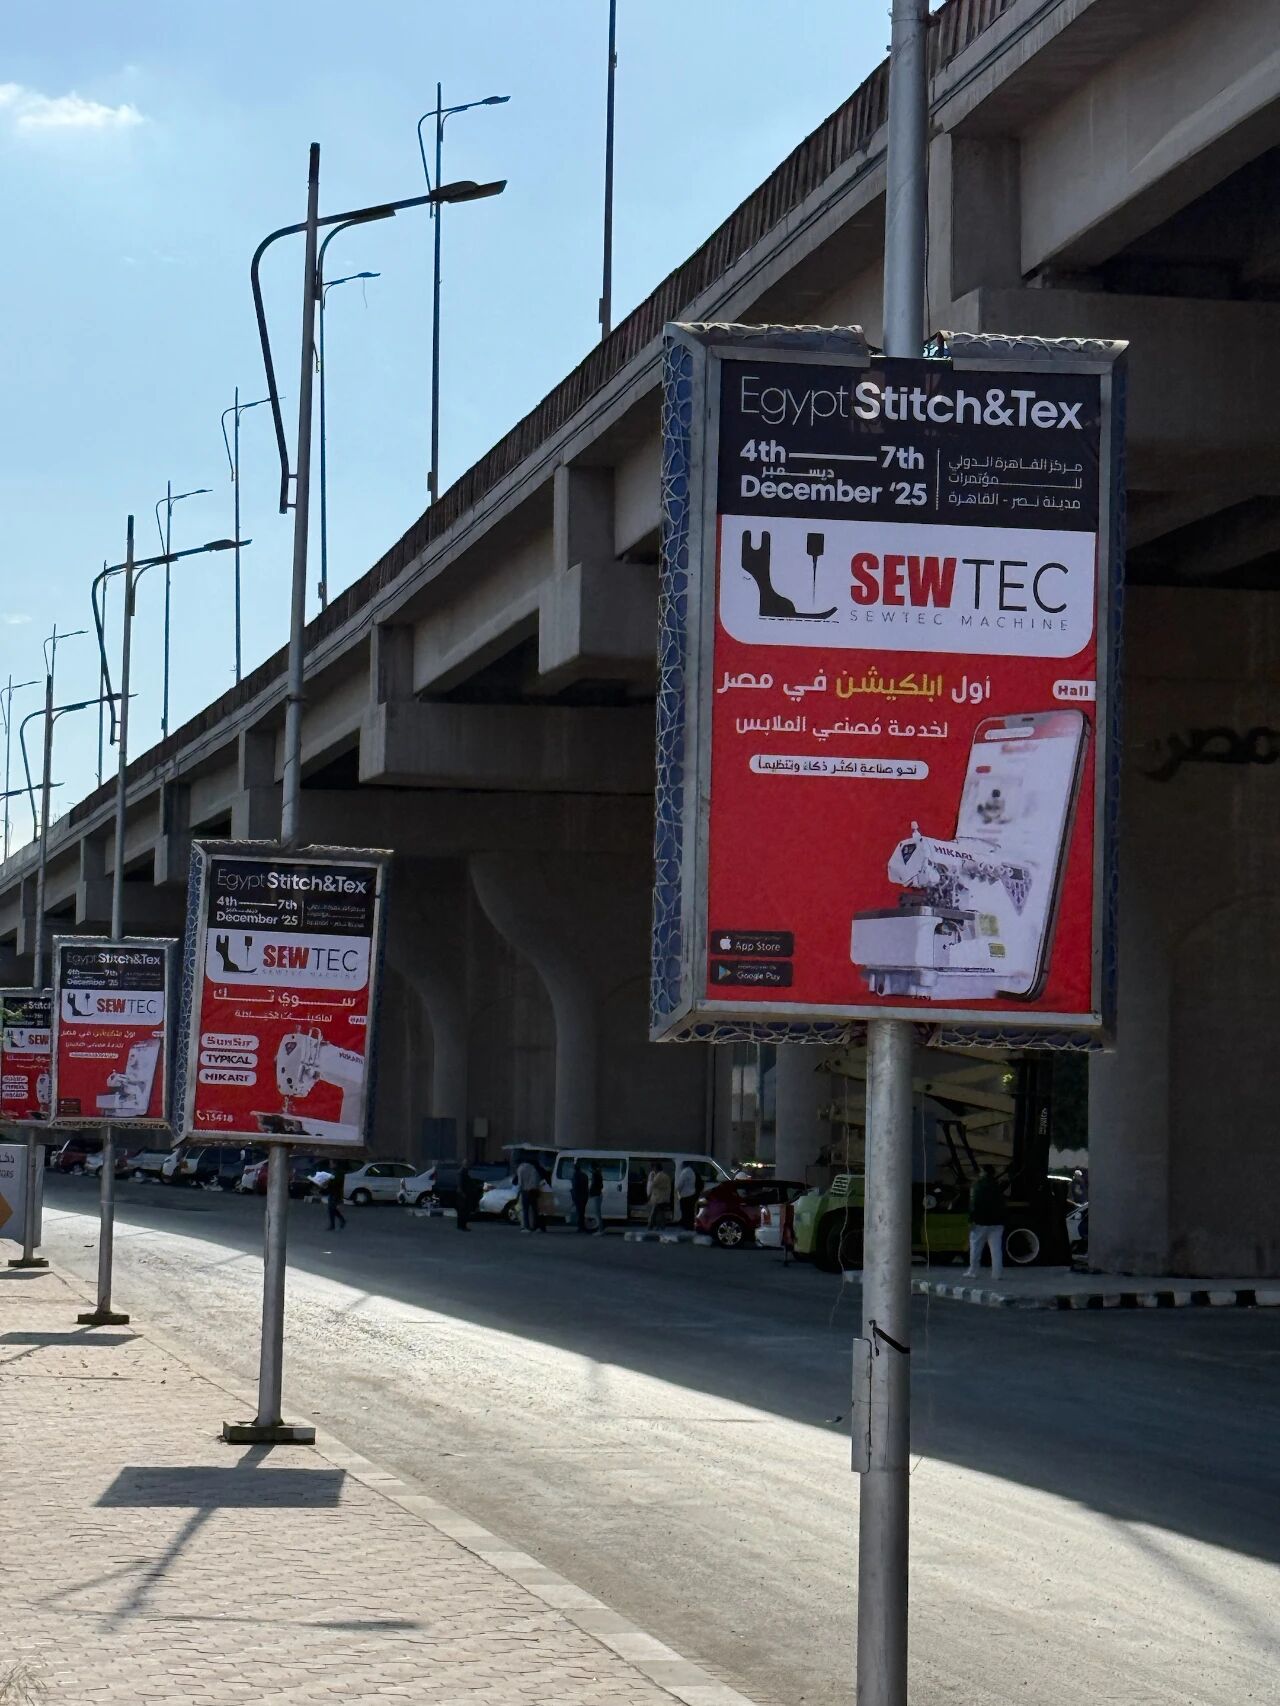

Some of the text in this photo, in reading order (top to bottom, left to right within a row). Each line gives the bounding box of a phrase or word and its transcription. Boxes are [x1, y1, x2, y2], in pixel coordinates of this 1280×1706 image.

[740, 375, 1084, 430] Egypt Stitch&Tex
[740, 439, 925, 470] 4th 7th
[948, 455, 1083, 474] مركز القاهرة الدولي
[740, 474, 883, 504] December
[948, 491, 999, 506] القاهرة
[1011, 495, 1040, 509] نصر
[1043, 495, 1081, 511] مدينة
[850, 609, 1069, 632] SEWTEC MACHINE
[717, 665, 991, 704] أول ابلكيشن في مصر
[1057, 683, 1089, 698] Hall
[736, 715, 807, 737] الملابس
[888, 719, 948, 738] لخدمة
[896, 764, 917, 777] نحو
[217, 867, 367, 895] Egypt Stitch&Tex
[216, 895, 238, 907] 4th
[277, 899, 298, 911] 7th
[216, 911, 278, 925] December
[735, 941, 781, 951] App Store
[206, 1054, 252, 1065] TYPICAL
